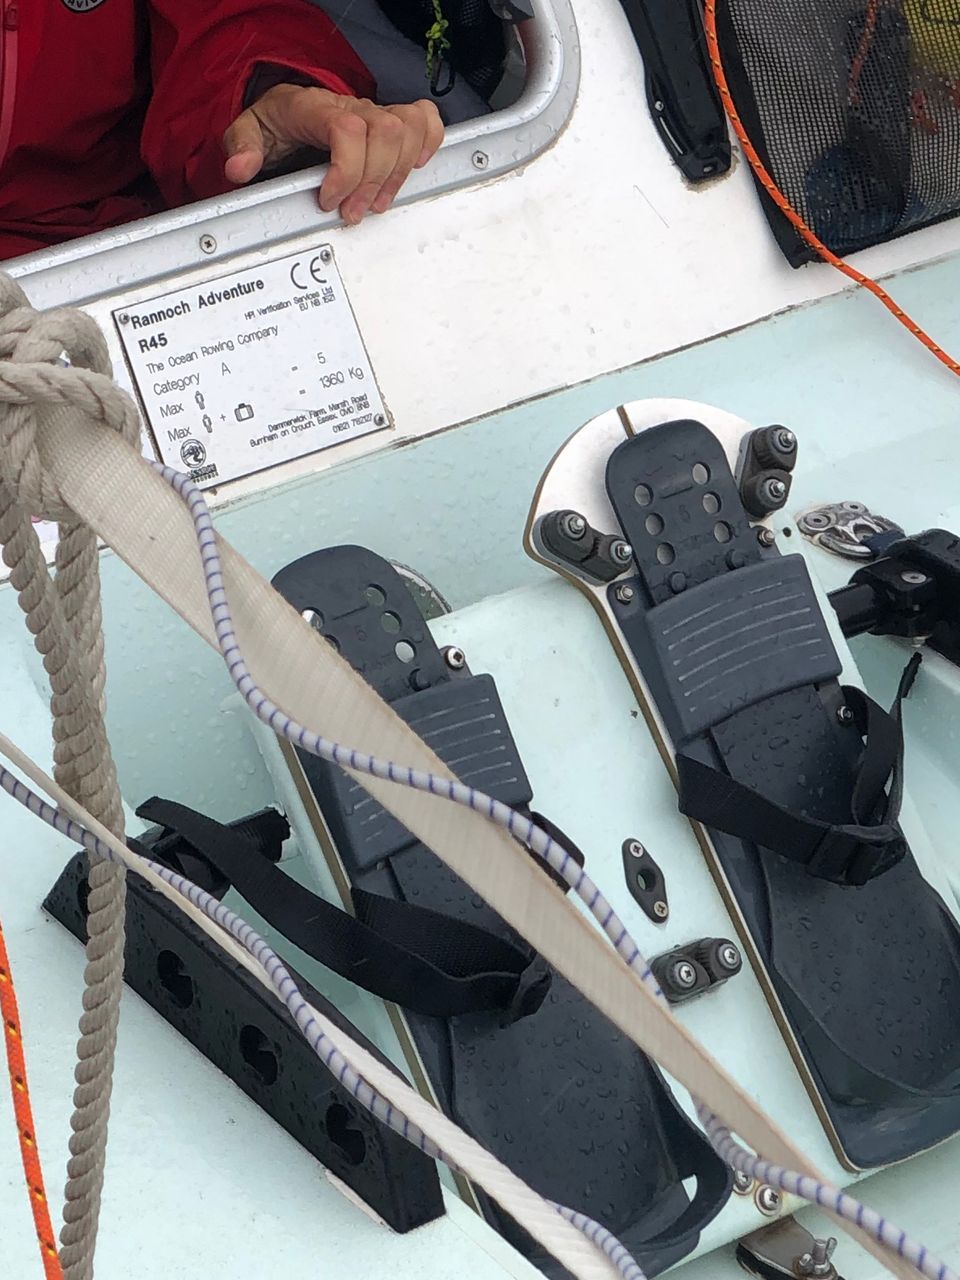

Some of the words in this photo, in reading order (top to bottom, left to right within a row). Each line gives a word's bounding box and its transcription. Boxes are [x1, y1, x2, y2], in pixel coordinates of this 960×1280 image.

[130, 300, 191, 330] Rannoch
[197, 278, 265, 310] Adventure
[138, 332, 168, 353] R45
[146, 360, 165, 376] The
[168, 350, 198, 368] Ocean
[200, 338, 235, 360] Rowing
[237, 324, 279, 347] Company
[153, 371, 201, 396] Category
[220, 362, 232, 376] A
[159, 400, 184, 419] Max
[316, 351, 327, 365] 5
[351, 393, 367, 405] Road
[167, 425, 193, 443] Max
[319, 370, 345, 389] 1360
[347, 365, 364, 383] Kg
[280, 428, 289, 437] on
